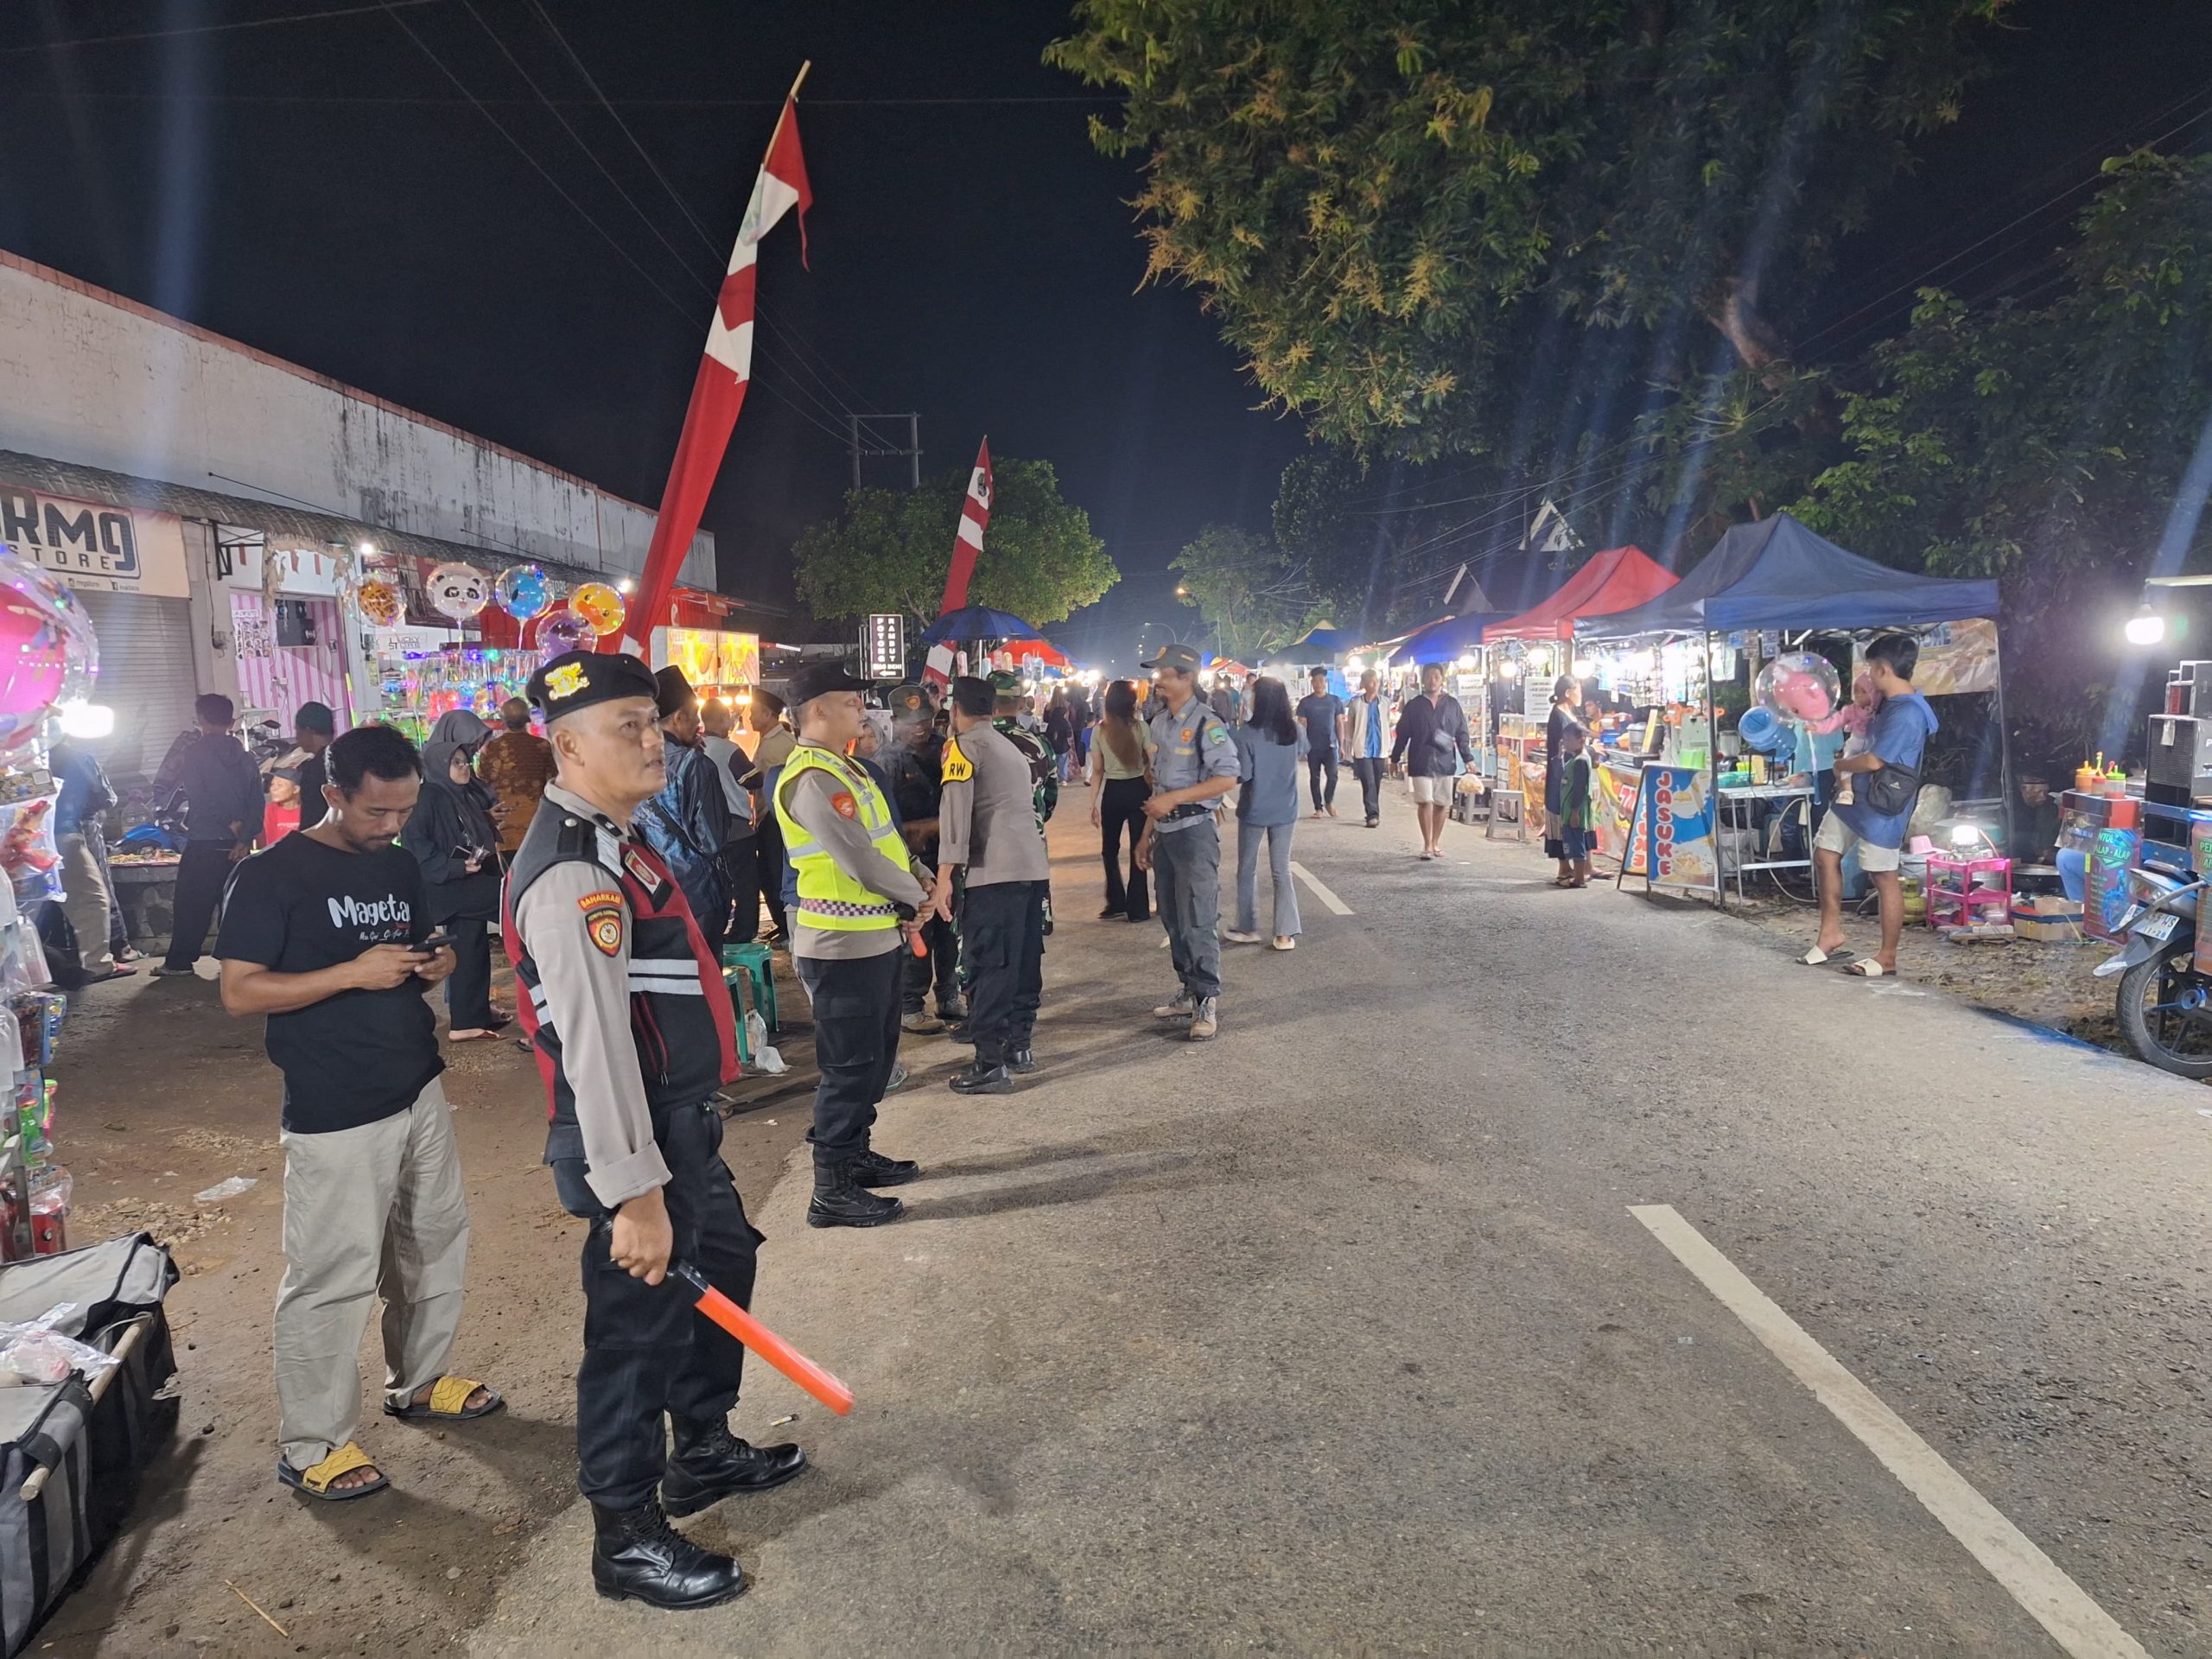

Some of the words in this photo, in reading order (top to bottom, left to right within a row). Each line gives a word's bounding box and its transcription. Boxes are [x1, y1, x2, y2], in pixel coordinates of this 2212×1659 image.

[877, 617, 886, 663] POTONG
[887, 618, 896, 662] RAMBUT
[950, 763, 966, 777] RW
[1656, 772, 1674, 876] JASUKE
